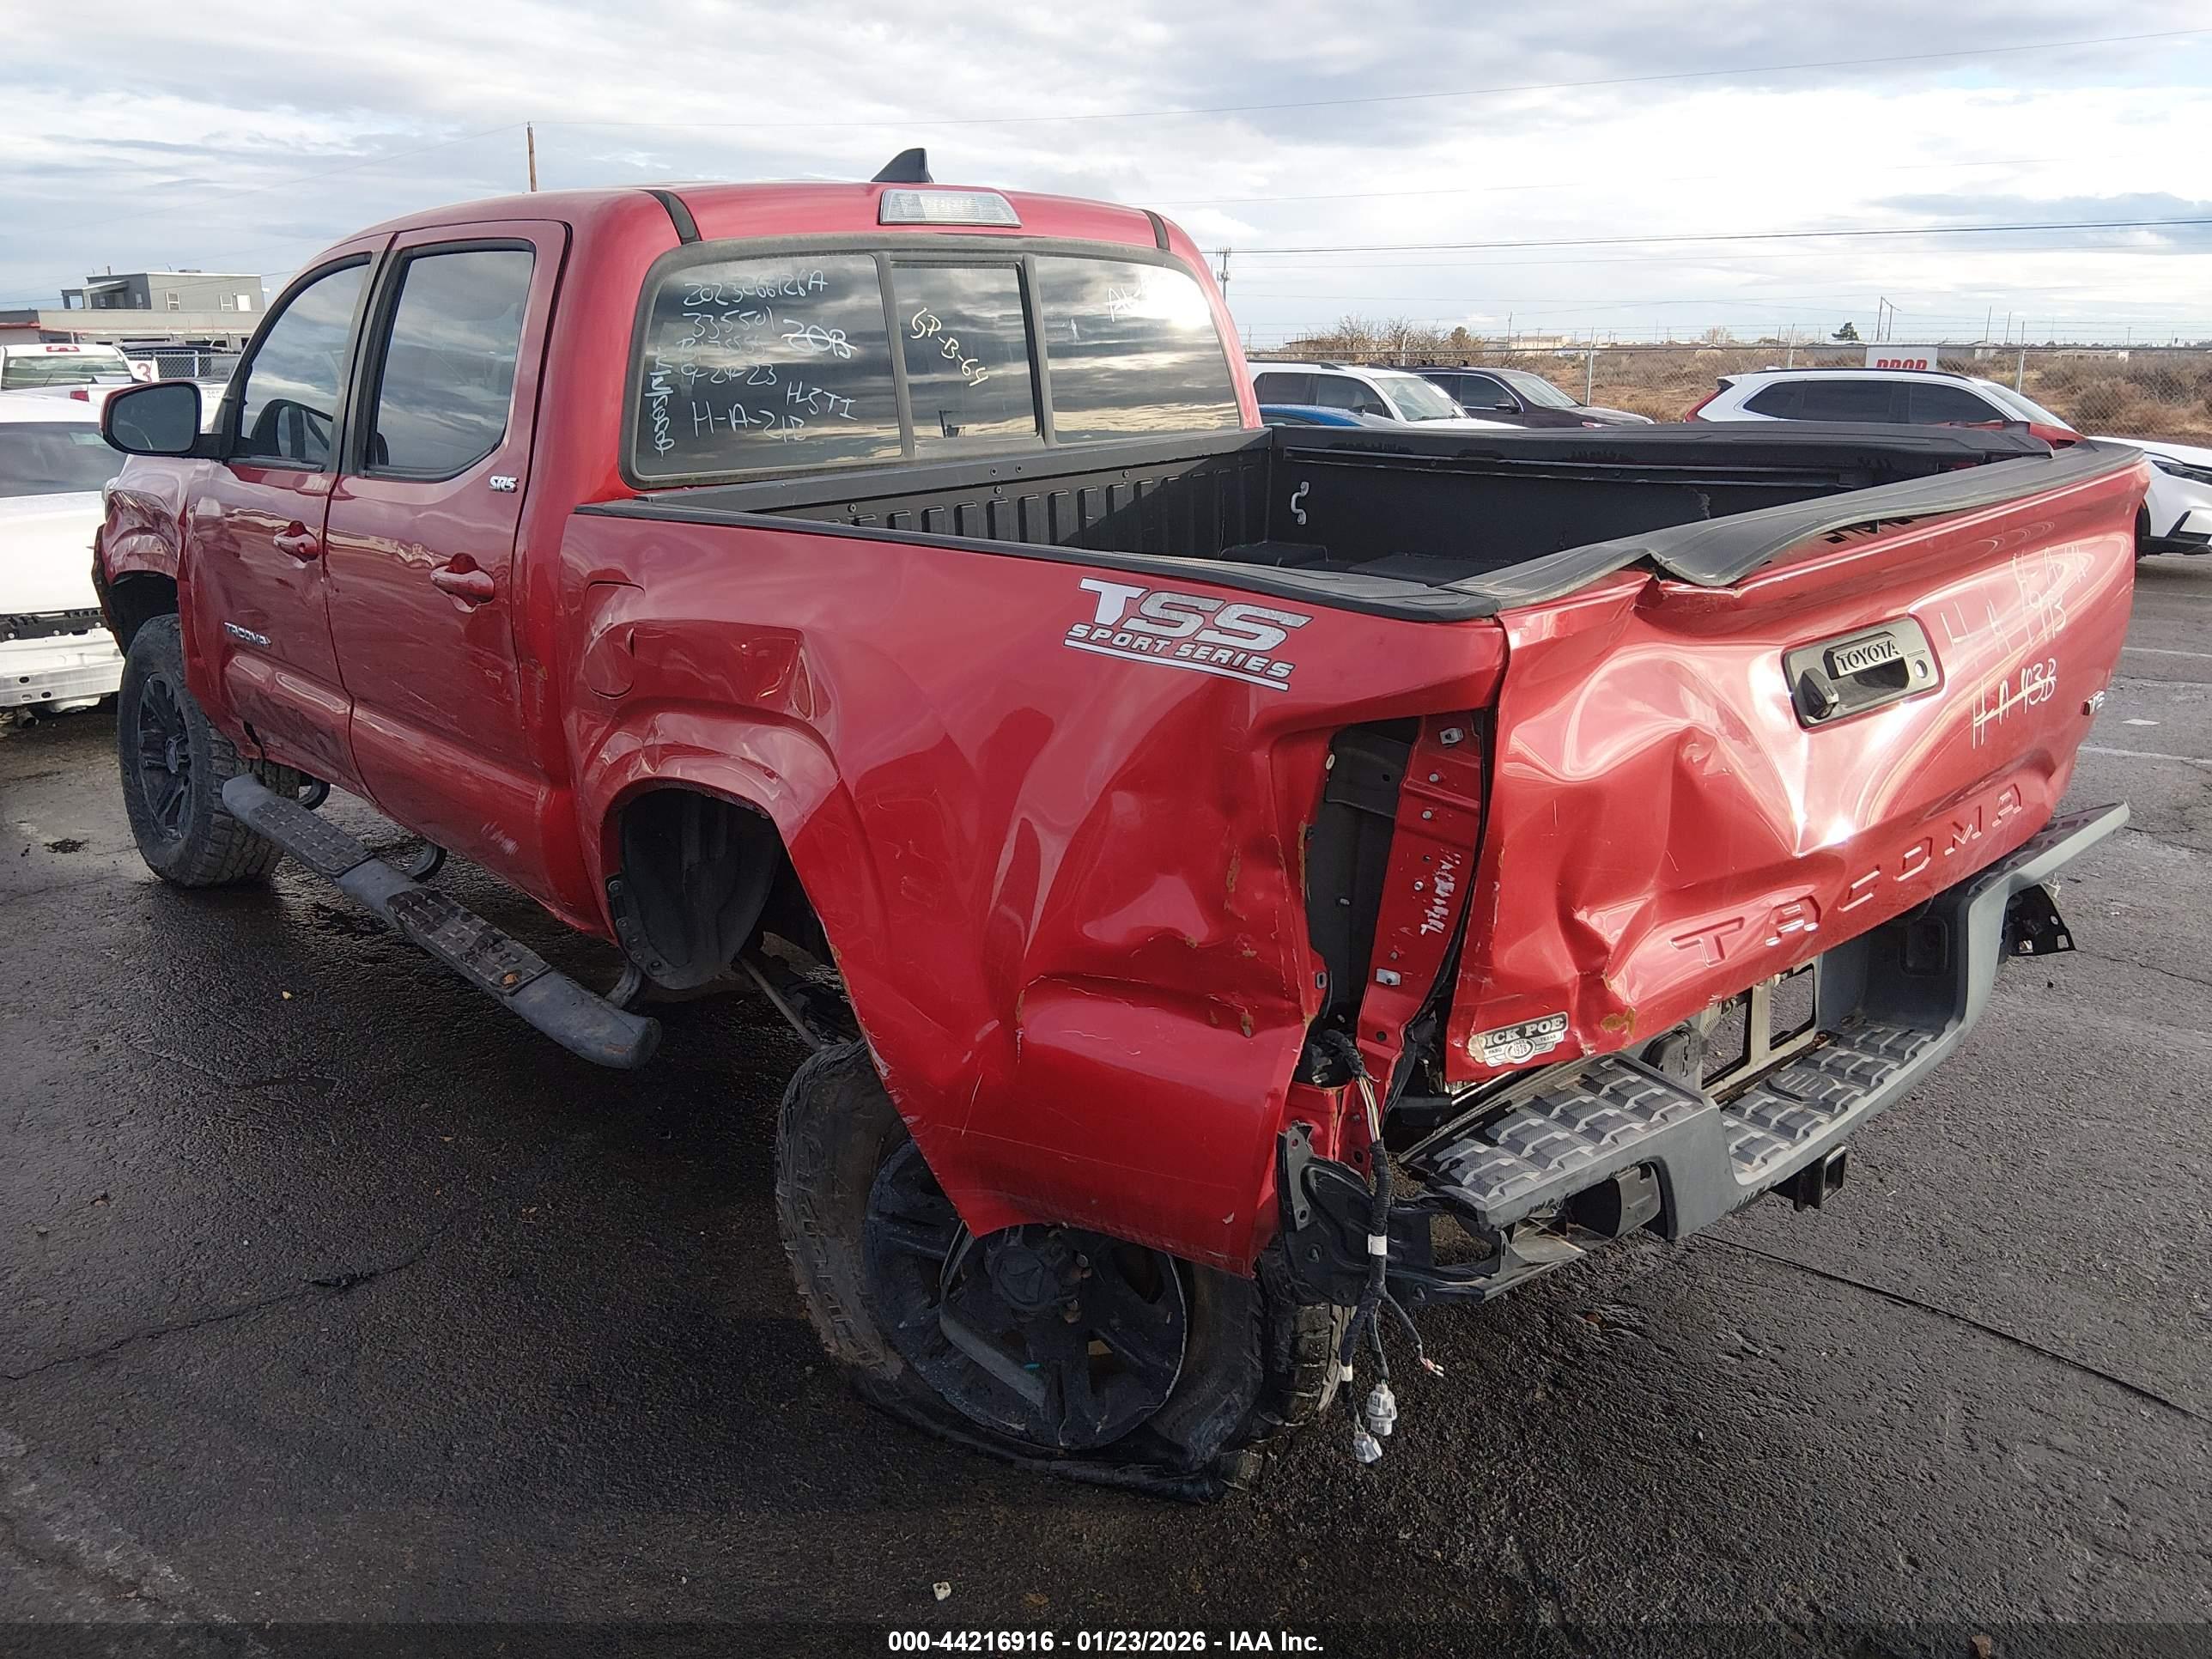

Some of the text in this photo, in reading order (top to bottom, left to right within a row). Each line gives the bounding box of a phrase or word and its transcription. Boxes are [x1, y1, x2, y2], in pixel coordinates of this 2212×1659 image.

[489, 475, 519, 493] SR5
[1078, 576, 1314, 653] TSS
[1066, 623, 1296, 678] SPORT SERIES
[1836, 639, 1900, 672] TOYOTA
[1667, 780, 2024, 969] TACOMA
[1525, 1017, 1564, 1037] POE
